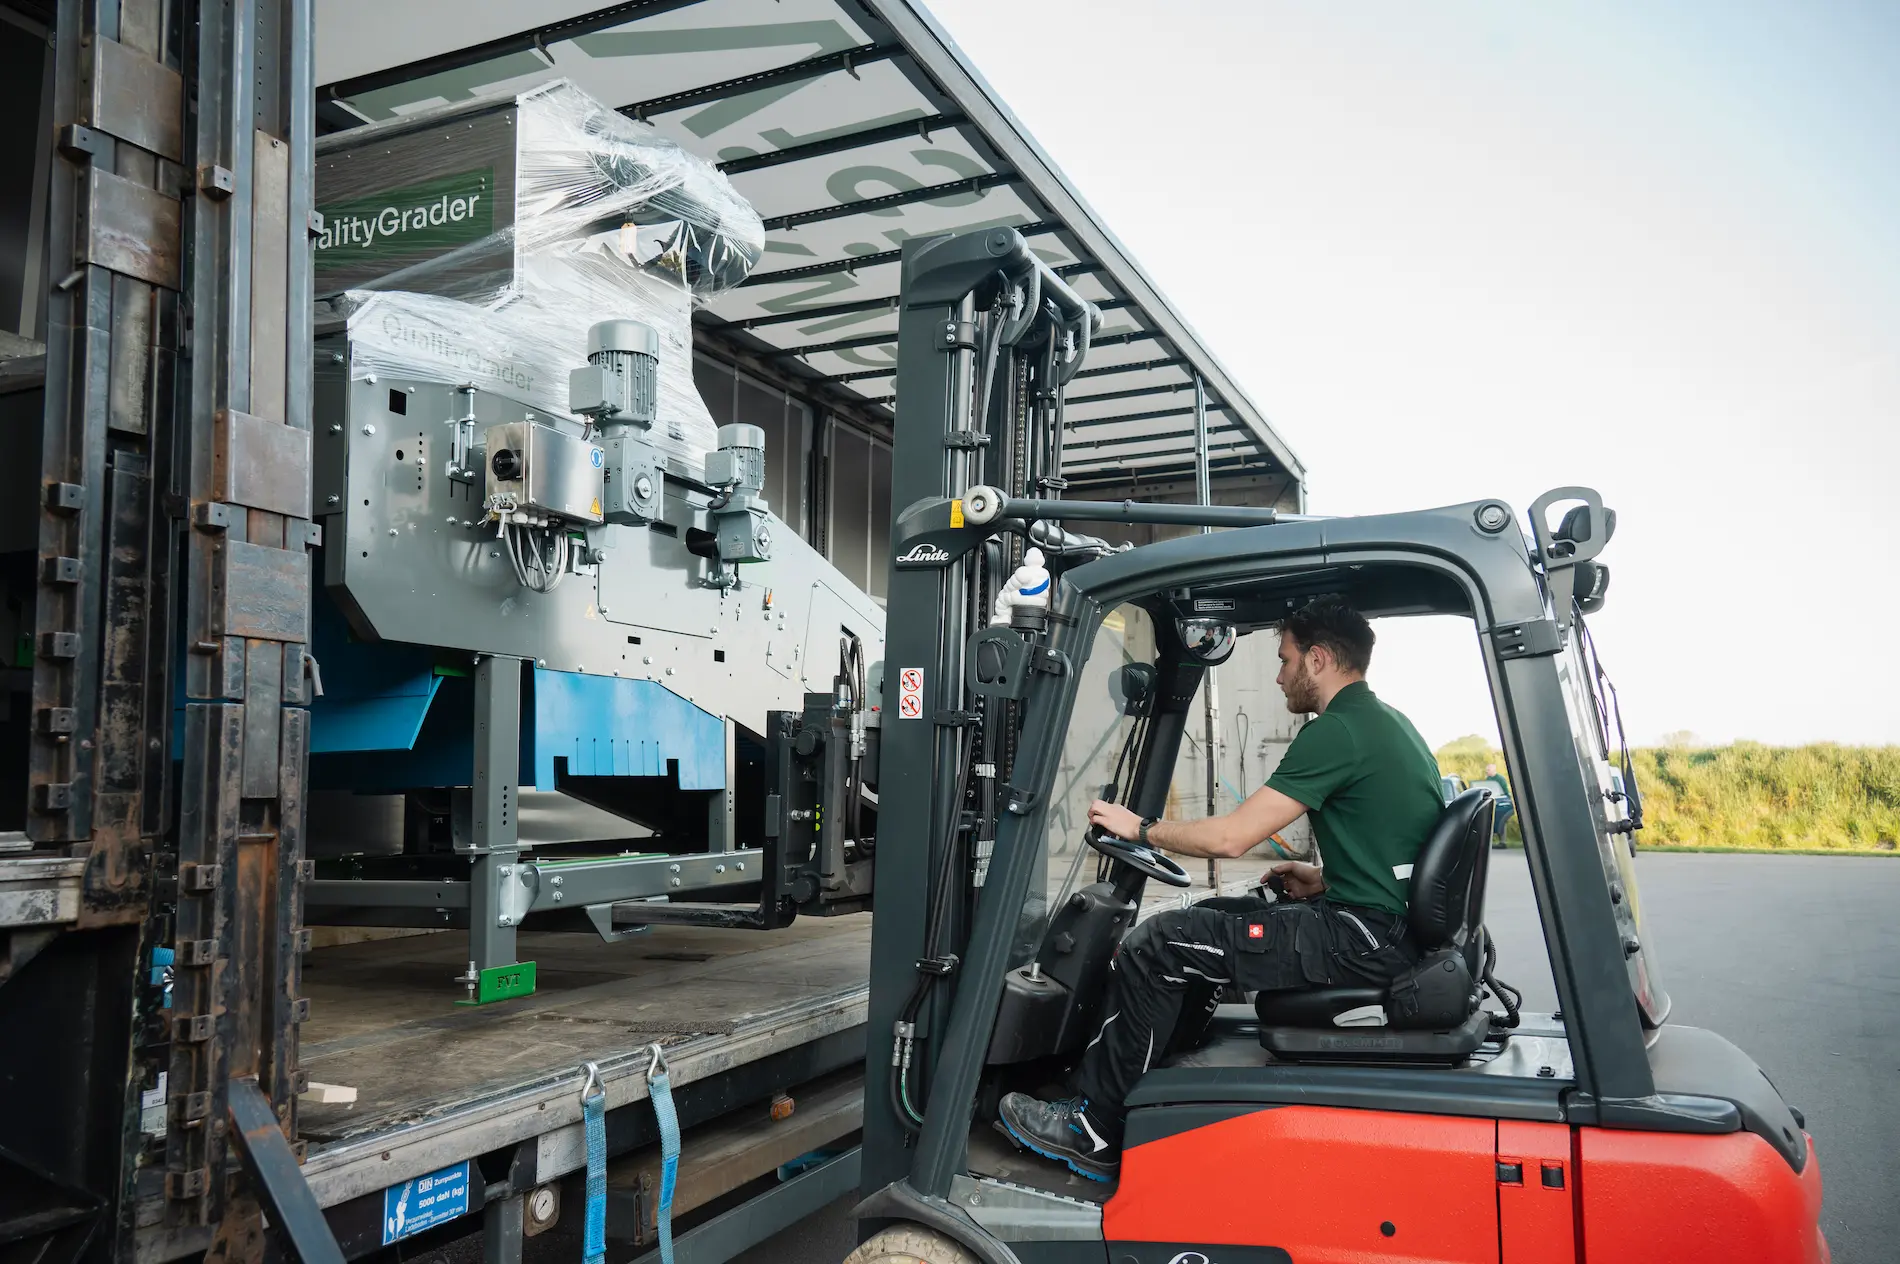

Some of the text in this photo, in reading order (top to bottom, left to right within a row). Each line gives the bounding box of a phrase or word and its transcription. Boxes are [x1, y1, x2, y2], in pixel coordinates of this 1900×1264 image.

[314, 195, 480, 250] alityGrader
[896, 543, 950, 562] Linde
[497, 973, 521, 989] FVT
[419, 1178, 433, 1193] DIN
[418, 1196, 435, 1209] 5000
[451, 1185, 464, 1198] (kg)
